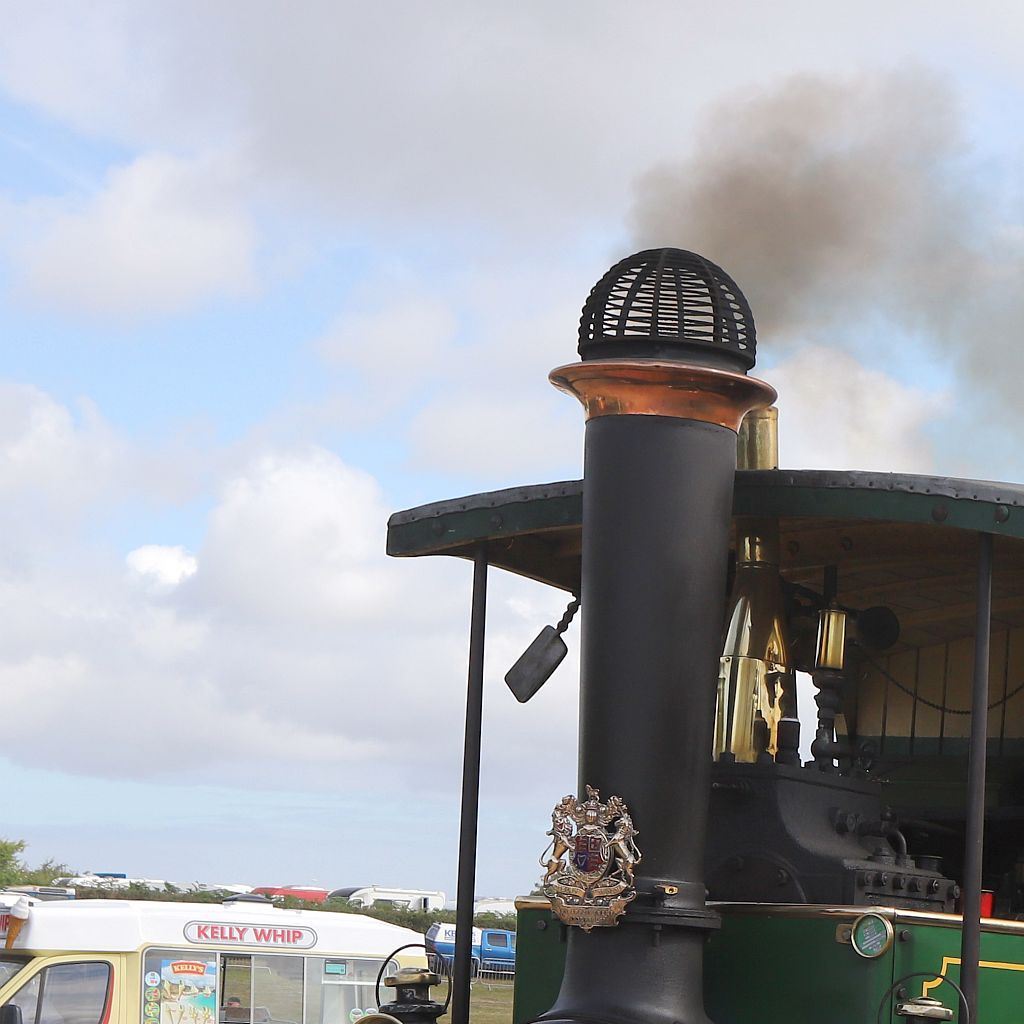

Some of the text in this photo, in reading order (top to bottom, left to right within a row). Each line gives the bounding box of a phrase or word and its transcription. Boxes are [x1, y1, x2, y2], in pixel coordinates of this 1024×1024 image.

[197, 925, 303, 944] KELLY WHIP
[173, 964, 204, 973] KELLY'S
